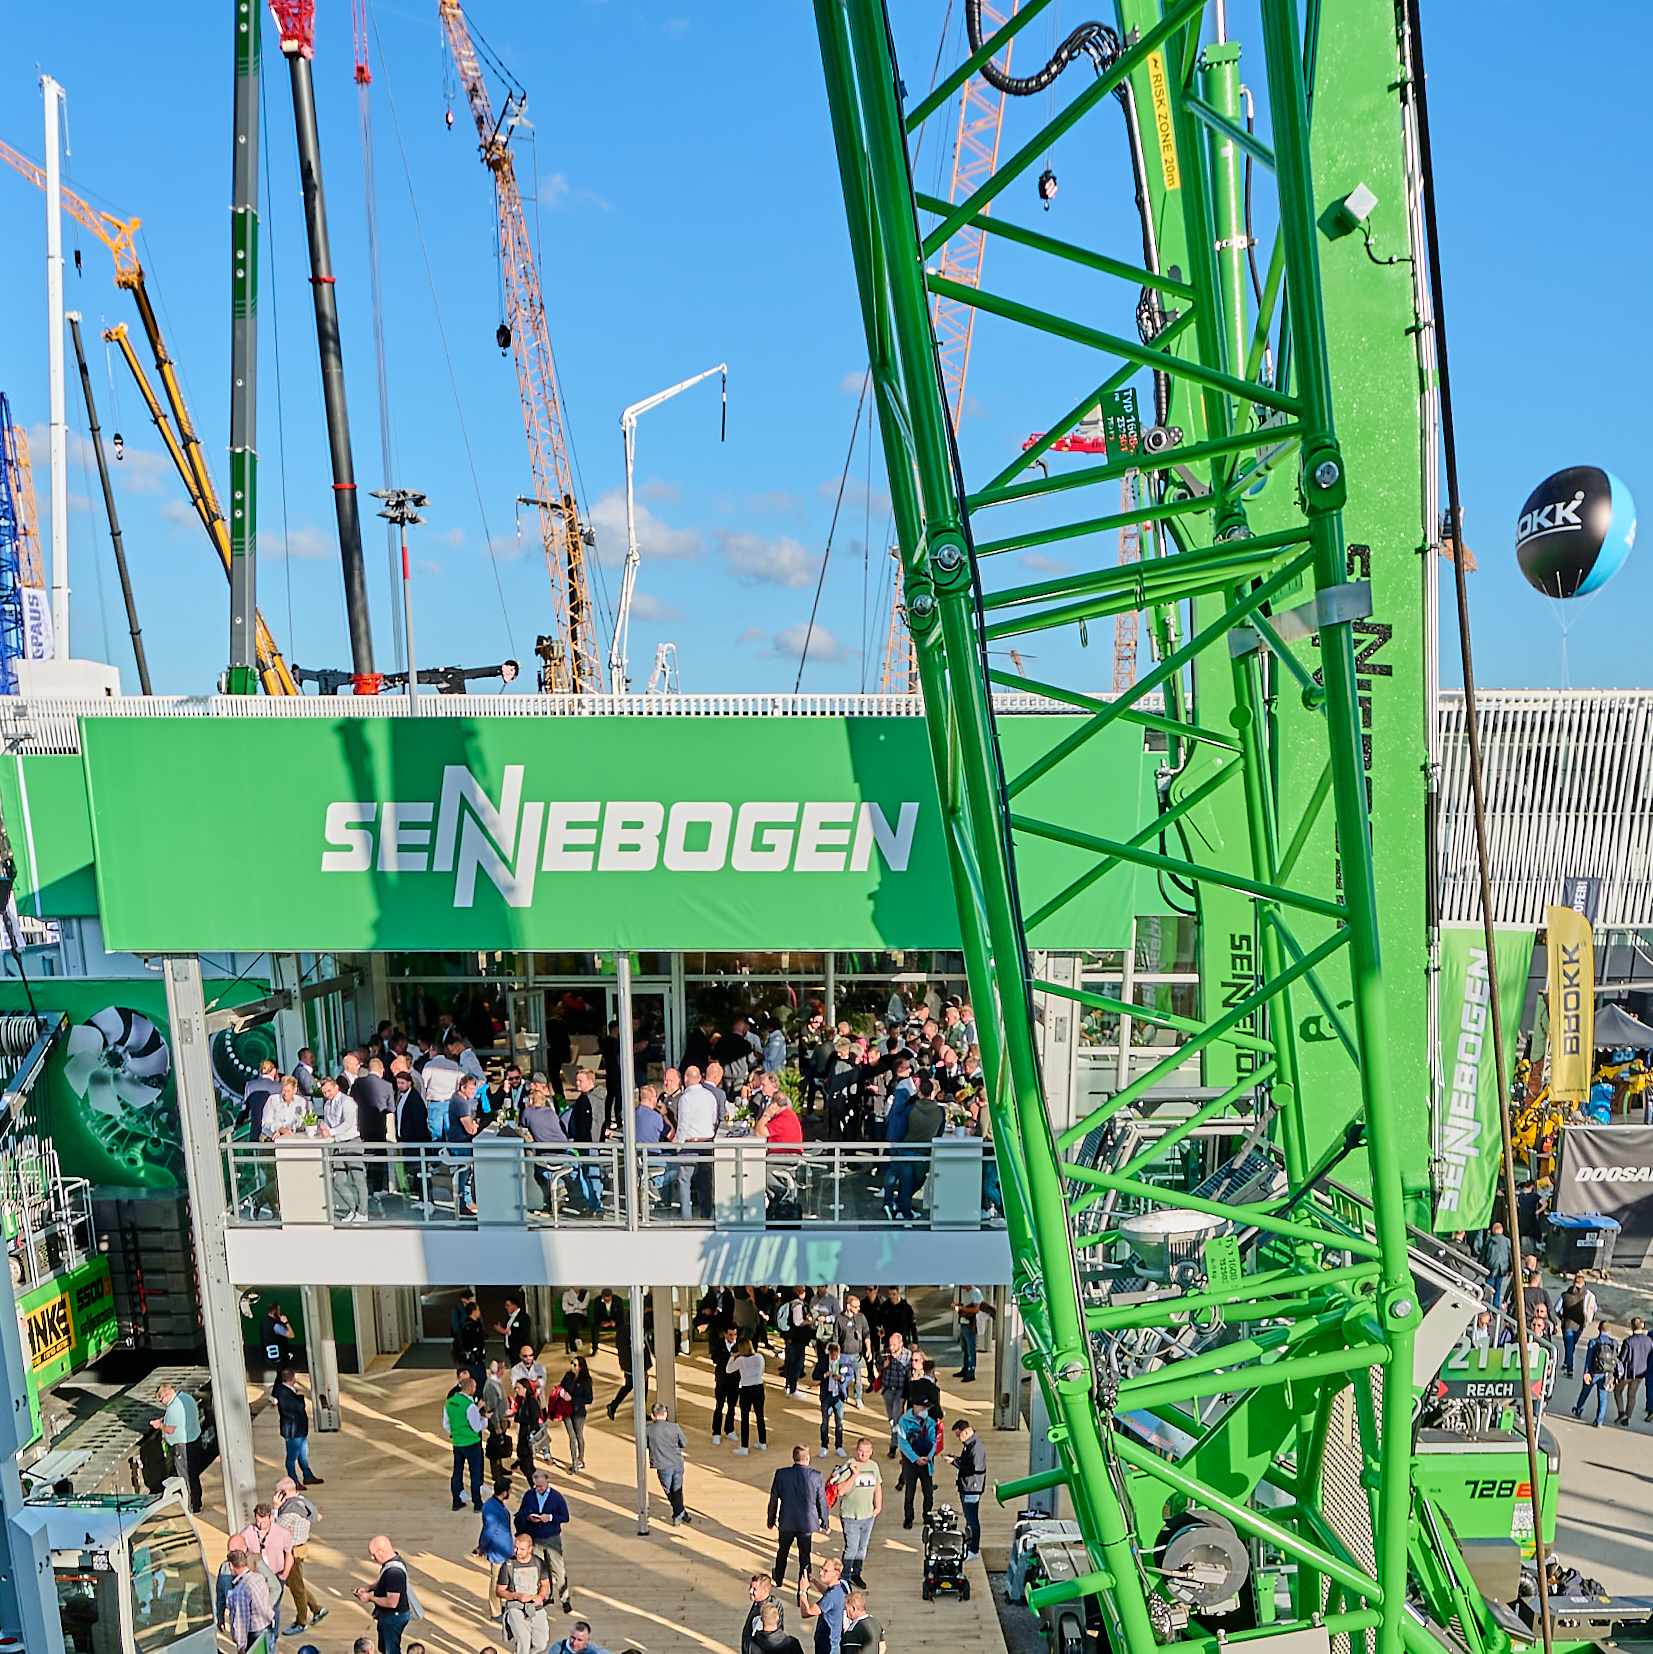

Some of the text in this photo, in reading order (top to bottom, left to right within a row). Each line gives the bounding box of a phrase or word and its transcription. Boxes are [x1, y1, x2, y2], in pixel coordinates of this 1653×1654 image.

[1517, 499, 1583, 542] OKK
[321, 764, 920, 908] SENNEBOGEN
[1561, 943, 1581, 1056] BROKK
[1438, 947, 1489, 1213] SENNEBOGEN
[1447, 1336, 1546, 1370] 21 m
[1466, 1382, 1514, 1397] REACH
